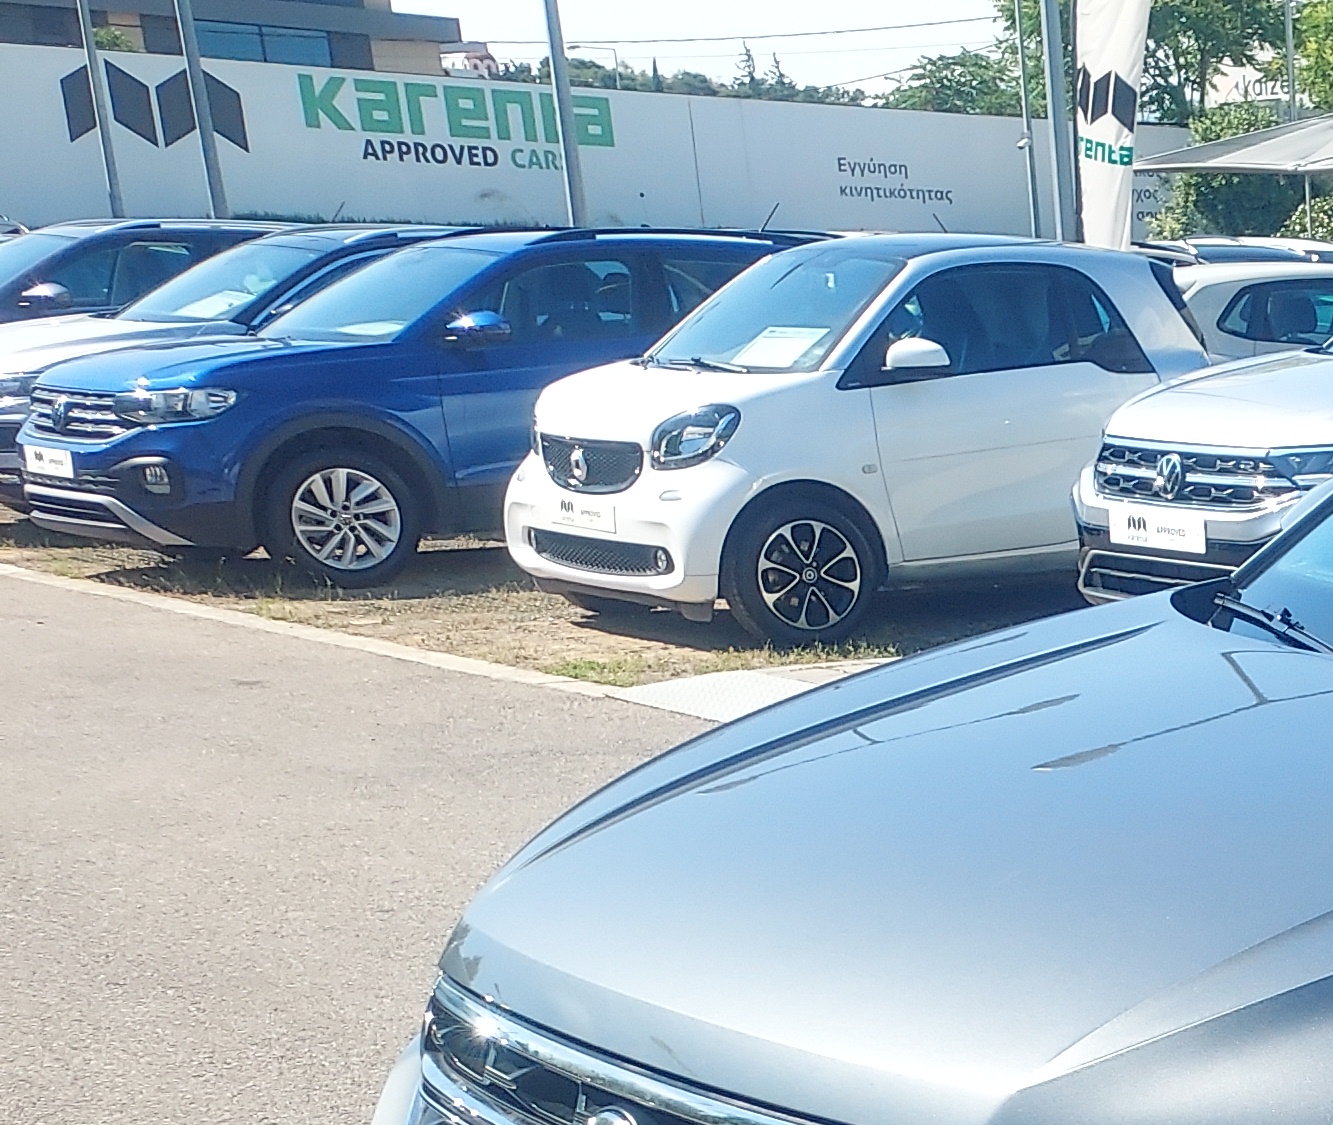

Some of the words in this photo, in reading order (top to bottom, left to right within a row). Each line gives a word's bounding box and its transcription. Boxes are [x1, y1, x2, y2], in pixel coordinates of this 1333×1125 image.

[363, 139, 499, 167] APPROVED
[511, 148, 564, 171] CAR
[837, 157, 908, 179] Εγγύηση
[839, 183, 953, 205] κινητικότητας
